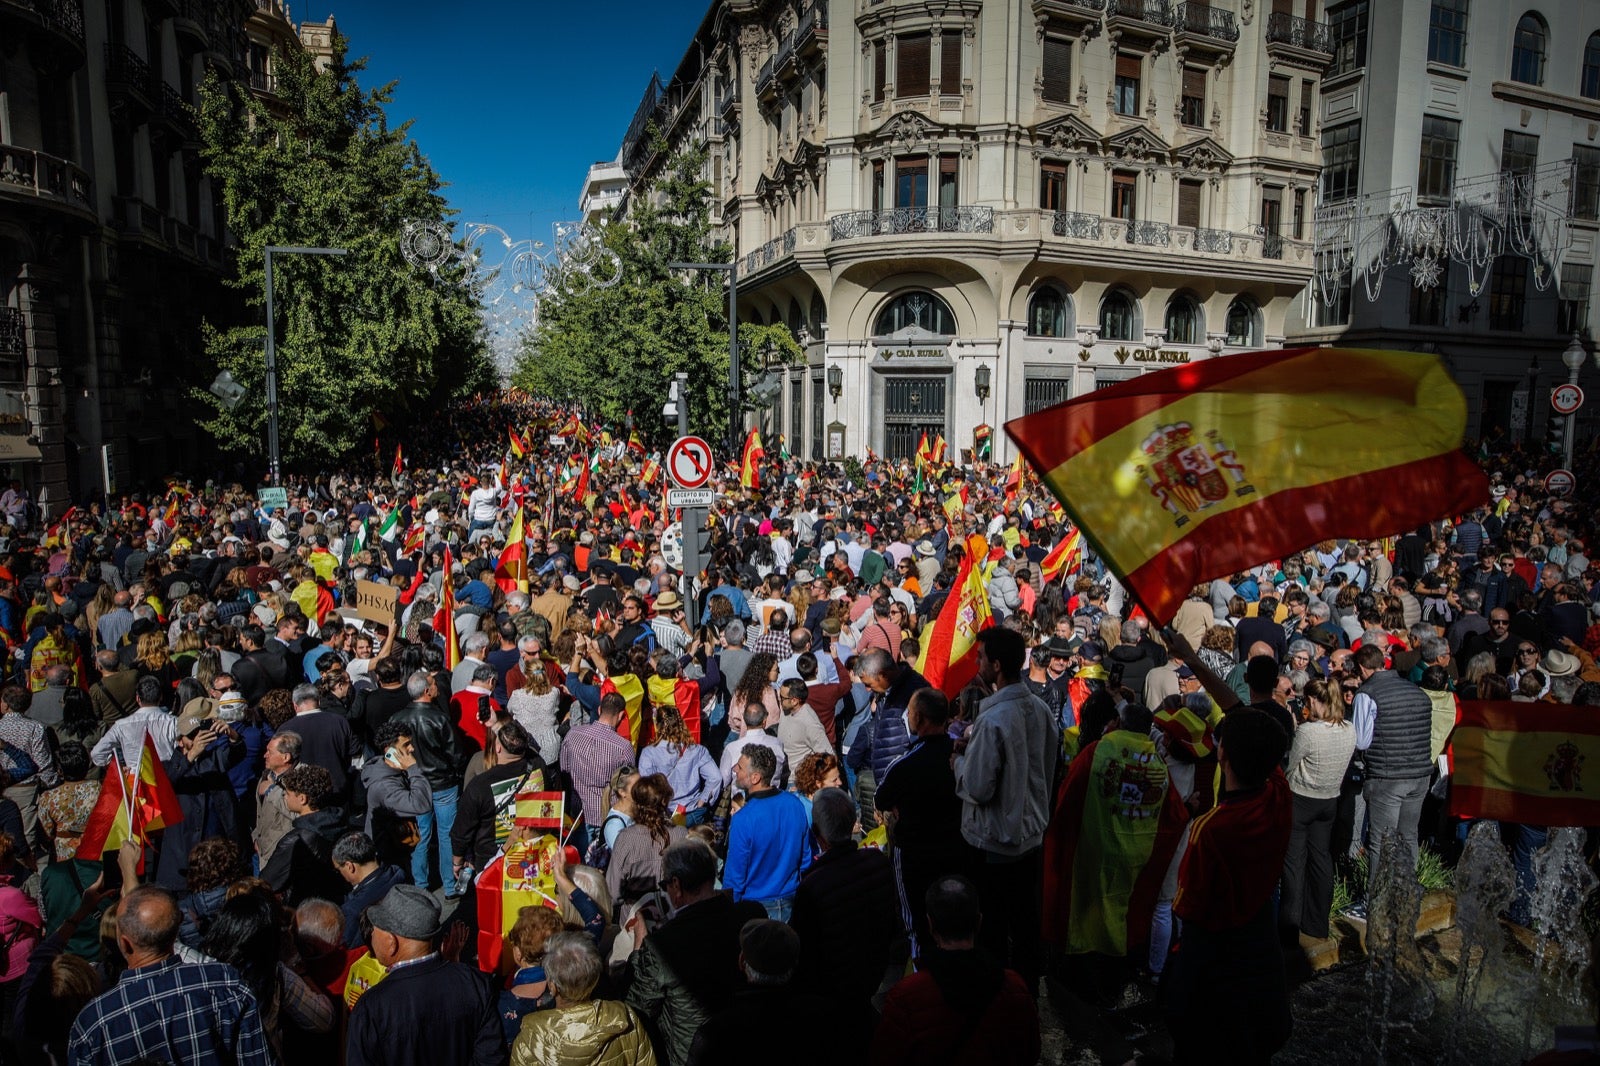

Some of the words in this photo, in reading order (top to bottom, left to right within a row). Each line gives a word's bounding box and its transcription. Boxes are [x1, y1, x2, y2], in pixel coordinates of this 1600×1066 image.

[896, 349, 915, 357] CAJA
[917, 349, 943, 357] RURAL
[1133, 349, 1157, 361] CAJA
[1158, 350, 1191, 363] RURAL
